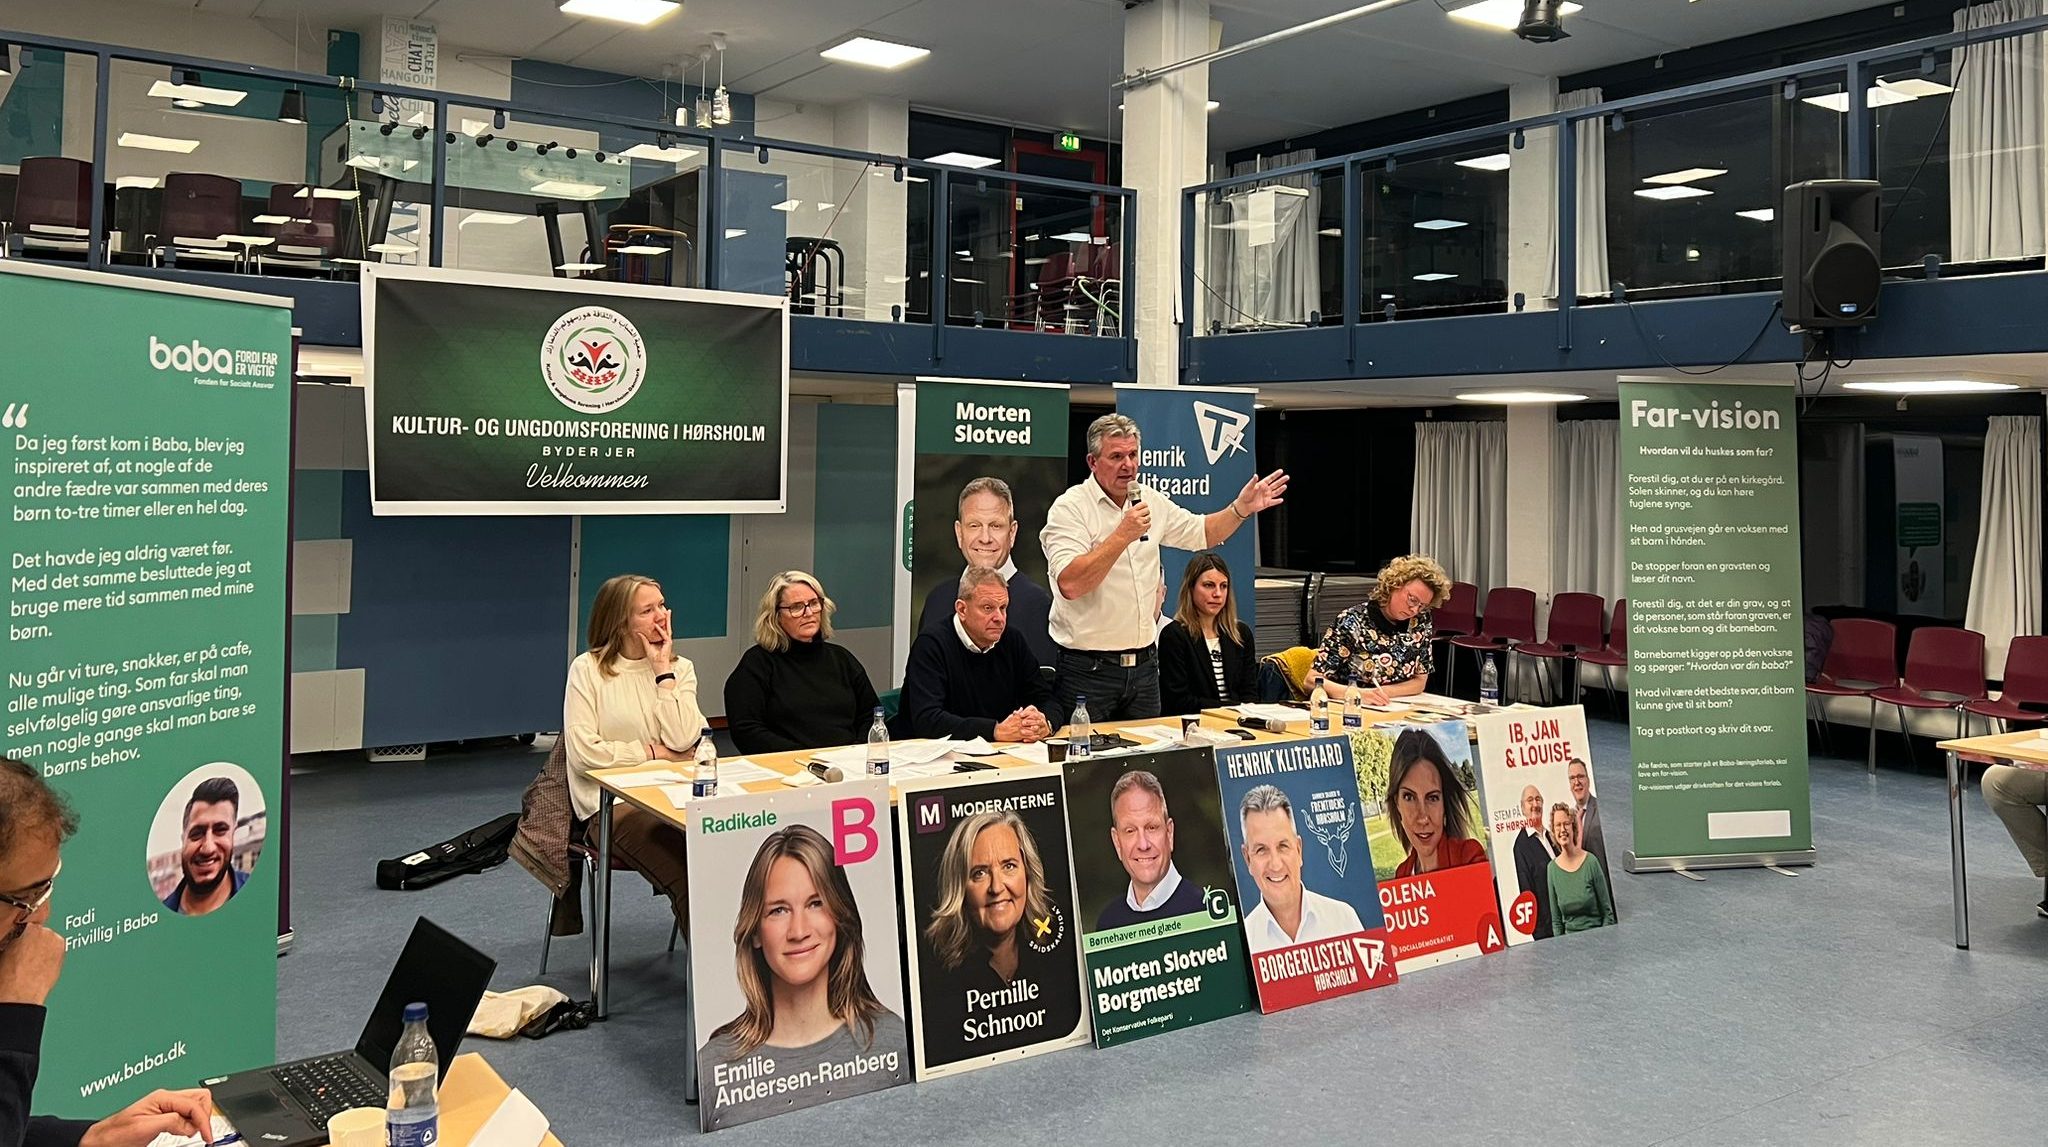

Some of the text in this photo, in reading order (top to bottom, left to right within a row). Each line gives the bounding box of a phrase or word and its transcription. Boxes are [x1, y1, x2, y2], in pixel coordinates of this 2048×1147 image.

[408, 41, 422, 72] CHAT
[424, 44, 435, 74] FREE
[150, 336, 233, 375] baba
[236, 350, 277, 365] FORDI FAR
[235, 364, 275, 377] ER VIGTIG
[957, 402, 1030, 422] Morten
[1631, 400, 1779, 429] Far-vision
[393, 416, 764, 441] KULTUR- OG UNGDOMSFORENING I HØRSHOLM
[955, 424, 1030, 444] Slotved
[16, 435, 244, 455] Da jeg først kom i Baba, blev jeg
[543, 446, 634, 457] BYDER JER
[1139, 446, 1186, 467] enrik
[1640, 446, 1678, 455] Hvordan
[1680, 447, 1690, 455] vil
[1692, 447, 1703, 455] du
[1705, 447, 1734, 456] huskes
[1756, 447, 1773, 456] far?
[15, 458, 213, 477] inspireret af, at nogle af de
[527, 463, 648, 488] Velkommen
[14, 479, 268, 497] andre fædre var sammen med deres
[1629, 474, 1659, 483] Forestil
[1662, 474, 1679, 485] dig,
[1691, 475, 1703, 483] du
[1716, 475, 1727, 485] på
[1742, 475, 1784, 486] kirkegård.
[1629, 487, 1652, 495] Solen
[1655, 487, 1688, 496] skinner,
[1690, 489, 1701, 498] og
[1703, 487, 1715, 496] du
[1717, 488, 1732, 496] kan
[1629, 499, 1692, 510] fuglene synge.
[14, 500, 247, 521] børn to-tre timer eller en hel dag.
[1630, 524, 1648, 532] Hen
[1650, 524, 1662, 532] ad
[1664, 524, 1706, 535] grusvejen
[1708, 524, 1723, 535] går
[1737, 525, 1767, 533] voksen
[1769, 525, 1788, 533] med
[1631, 536, 1706, 545] sit barn i hånden.
[1509, 719, 1560, 743] IB, JAN
[1636, 727, 1653, 737] Tag
[1655, 727, 1665, 735] et
[1667, 725, 1703, 736] postkort
[1705, 727, 1716, 735] og
[1718, 724, 1738, 733] skriv
[1740, 724, 1751, 733] dit
[1227, 743, 1343, 778] HENRIK KLITGAARD
[1506, 742, 1574, 768] & LOUISE
[921, 804, 940, 825] M
[952, 793, 1055, 818] MODERATERNE
[1494, 806, 1522, 821] STEM PÅ
[702, 810, 776, 834] Radikale
[830, 798, 878, 867] B
[1495, 816, 1541, 833] SF HØRSHO
[1212, 896, 1224, 914] C
[1379, 880, 1436, 906] OLENA
[66, 908, 95, 930] Fadi
[1383, 906, 1429, 932] DUUS
[1516, 902, 1533, 925] SF
[65, 913, 158, 952] Frivillig i Baba
[1028, 904, 1065, 953] SPIDSKANDIDAT
[1089, 921, 1183, 947] Børnehaver med glæde
[1487, 924, 1500, 948] A
[1399, 935, 1453, 953] SOCIALDEMOKRATIET
[1094, 942, 1227, 988] Morten Slotved
[1257, 939, 1354, 983] BORGERLISTEN
[1314, 966, 1358, 991] HØRSHOLM
[967, 981, 1039, 1012] Pernille
[1098, 975, 1201, 1013] Borgmester
[964, 1009, 1045, 1041] Schnoor
[1102, 1013, 1173, 1036] Det Konservative Folkeparti
[81, 1041, 186, 1097] www.baba.dk
[714, 1056, 775, 1086] Emilie
[715, 1051, 898, 1109] Andersen-Ranberg
